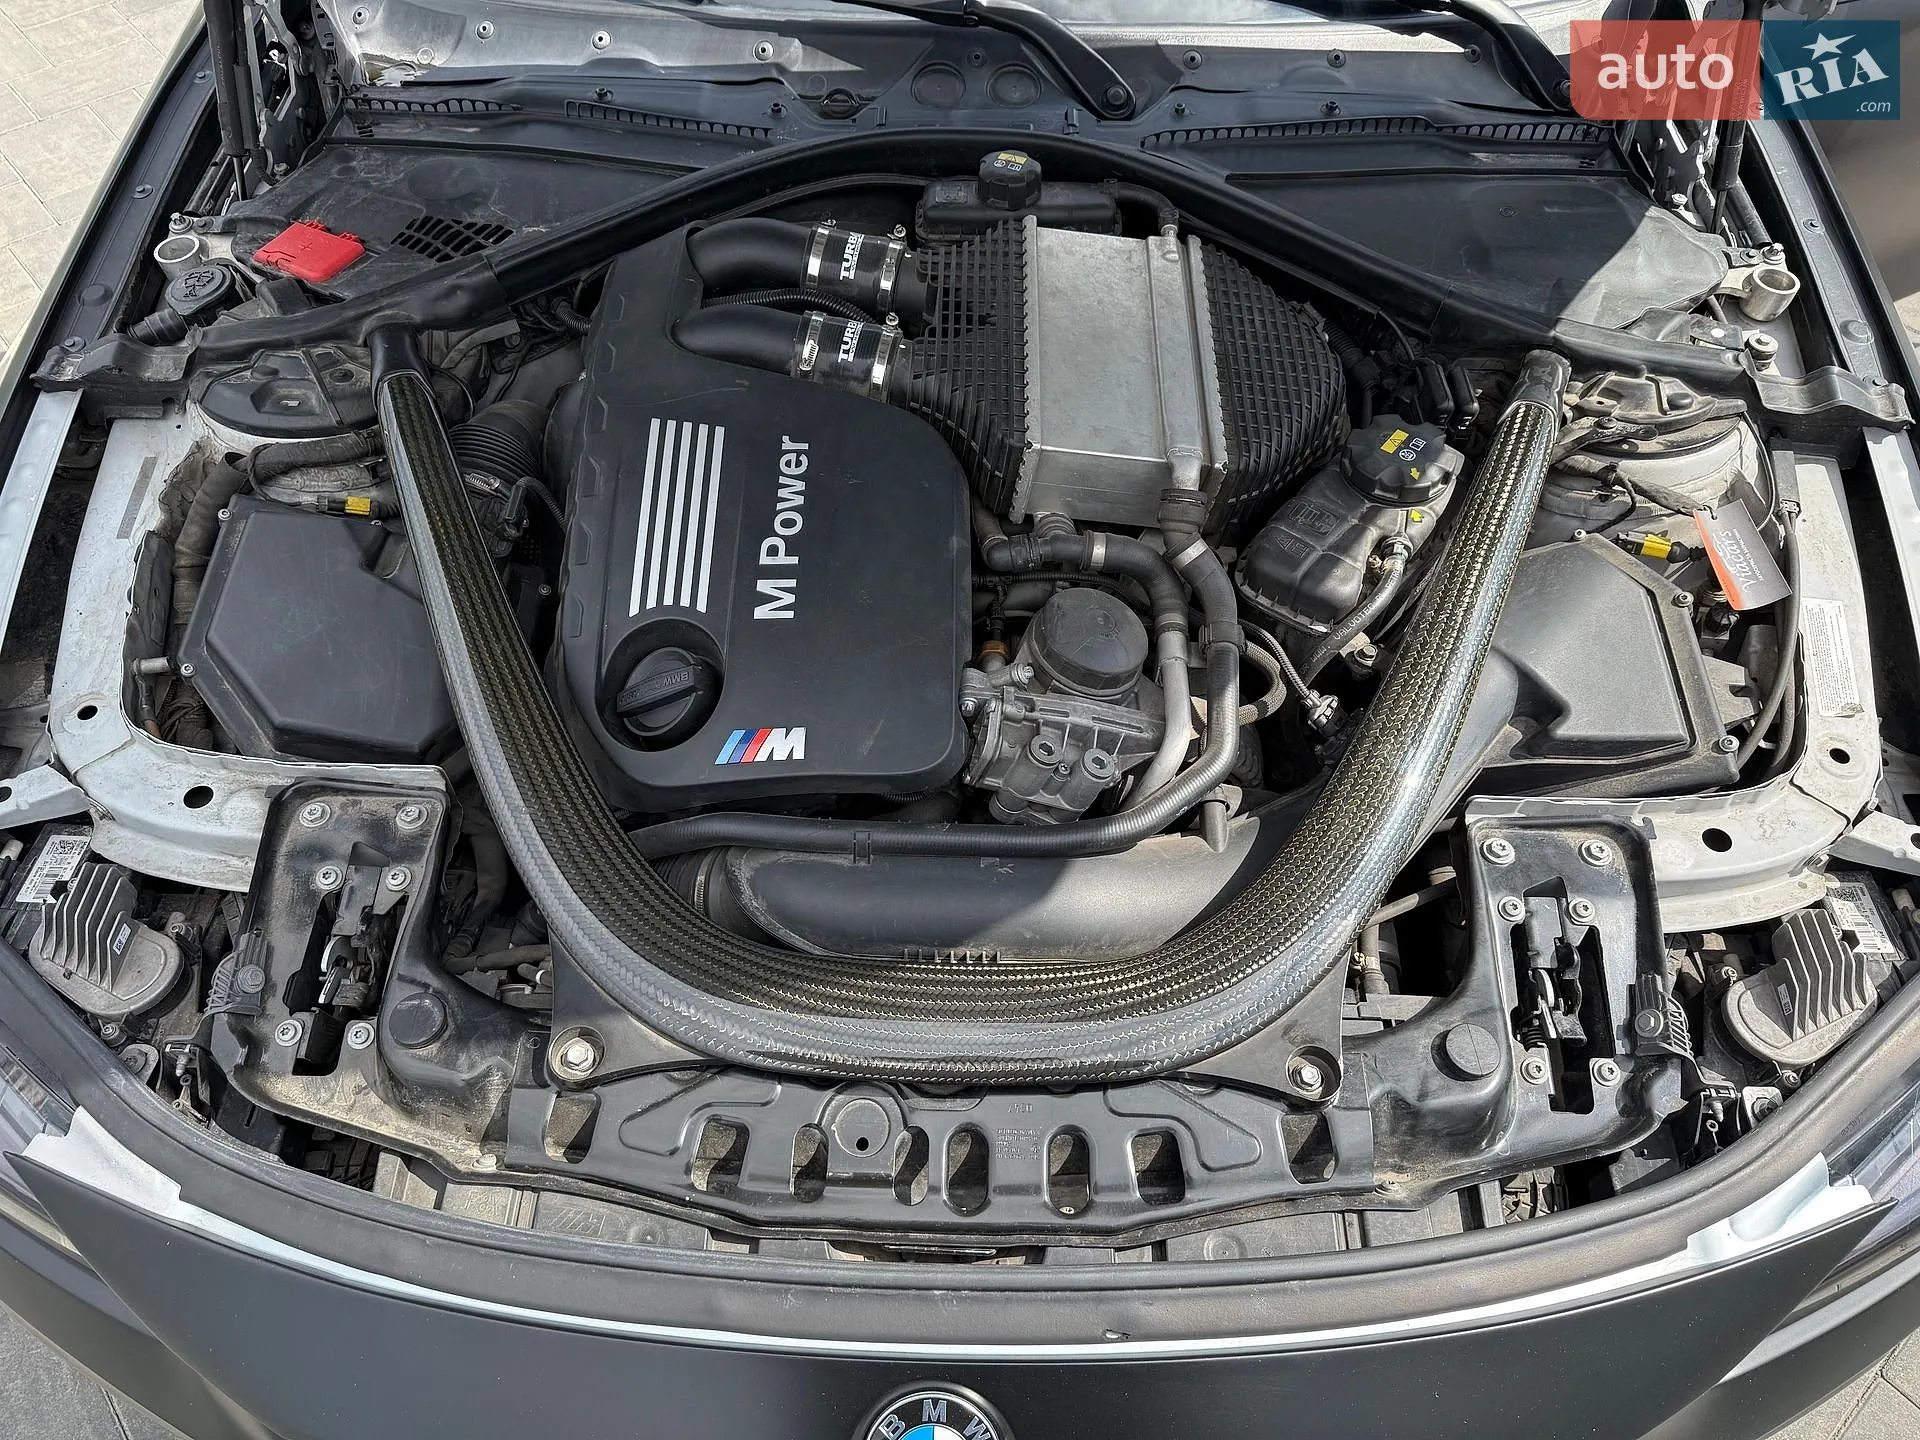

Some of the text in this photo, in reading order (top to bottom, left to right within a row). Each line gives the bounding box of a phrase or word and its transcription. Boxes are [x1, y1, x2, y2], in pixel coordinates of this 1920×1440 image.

[840, 231, 859, 280] TURB
[754, 435, 809, 619] M Power
[1720, 530, 1757, 593] Viacars
[878, 1398, 992, 1440] BMW
